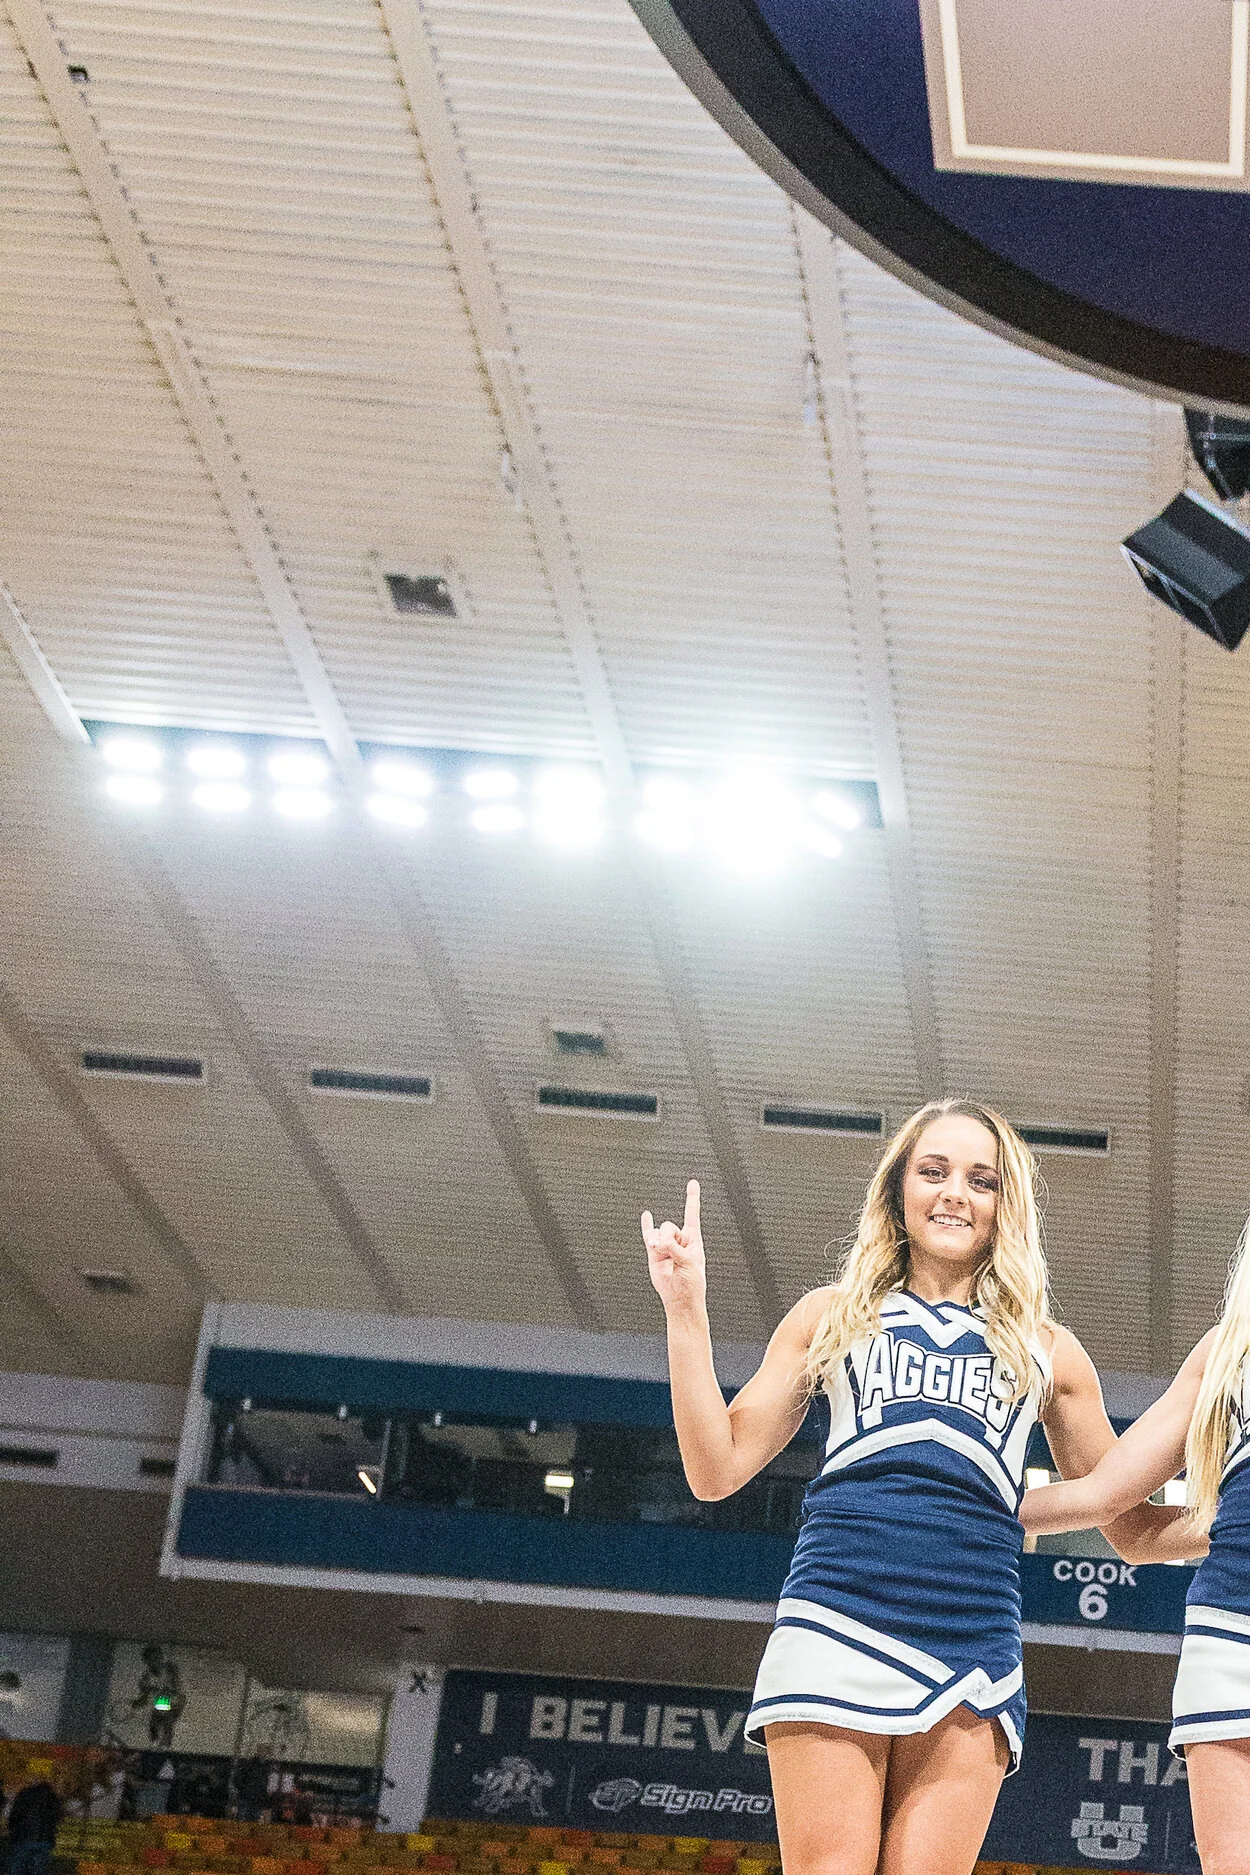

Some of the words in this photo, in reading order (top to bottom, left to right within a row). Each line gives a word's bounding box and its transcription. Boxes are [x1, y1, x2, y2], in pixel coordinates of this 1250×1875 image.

[860, 1331, 1017, 1434] AGGIES
[1053, 1560, 1137, 1586] COOK
[1078, 1583, 1108, 1620] 6
[479, 1692, 498, 1735] I
